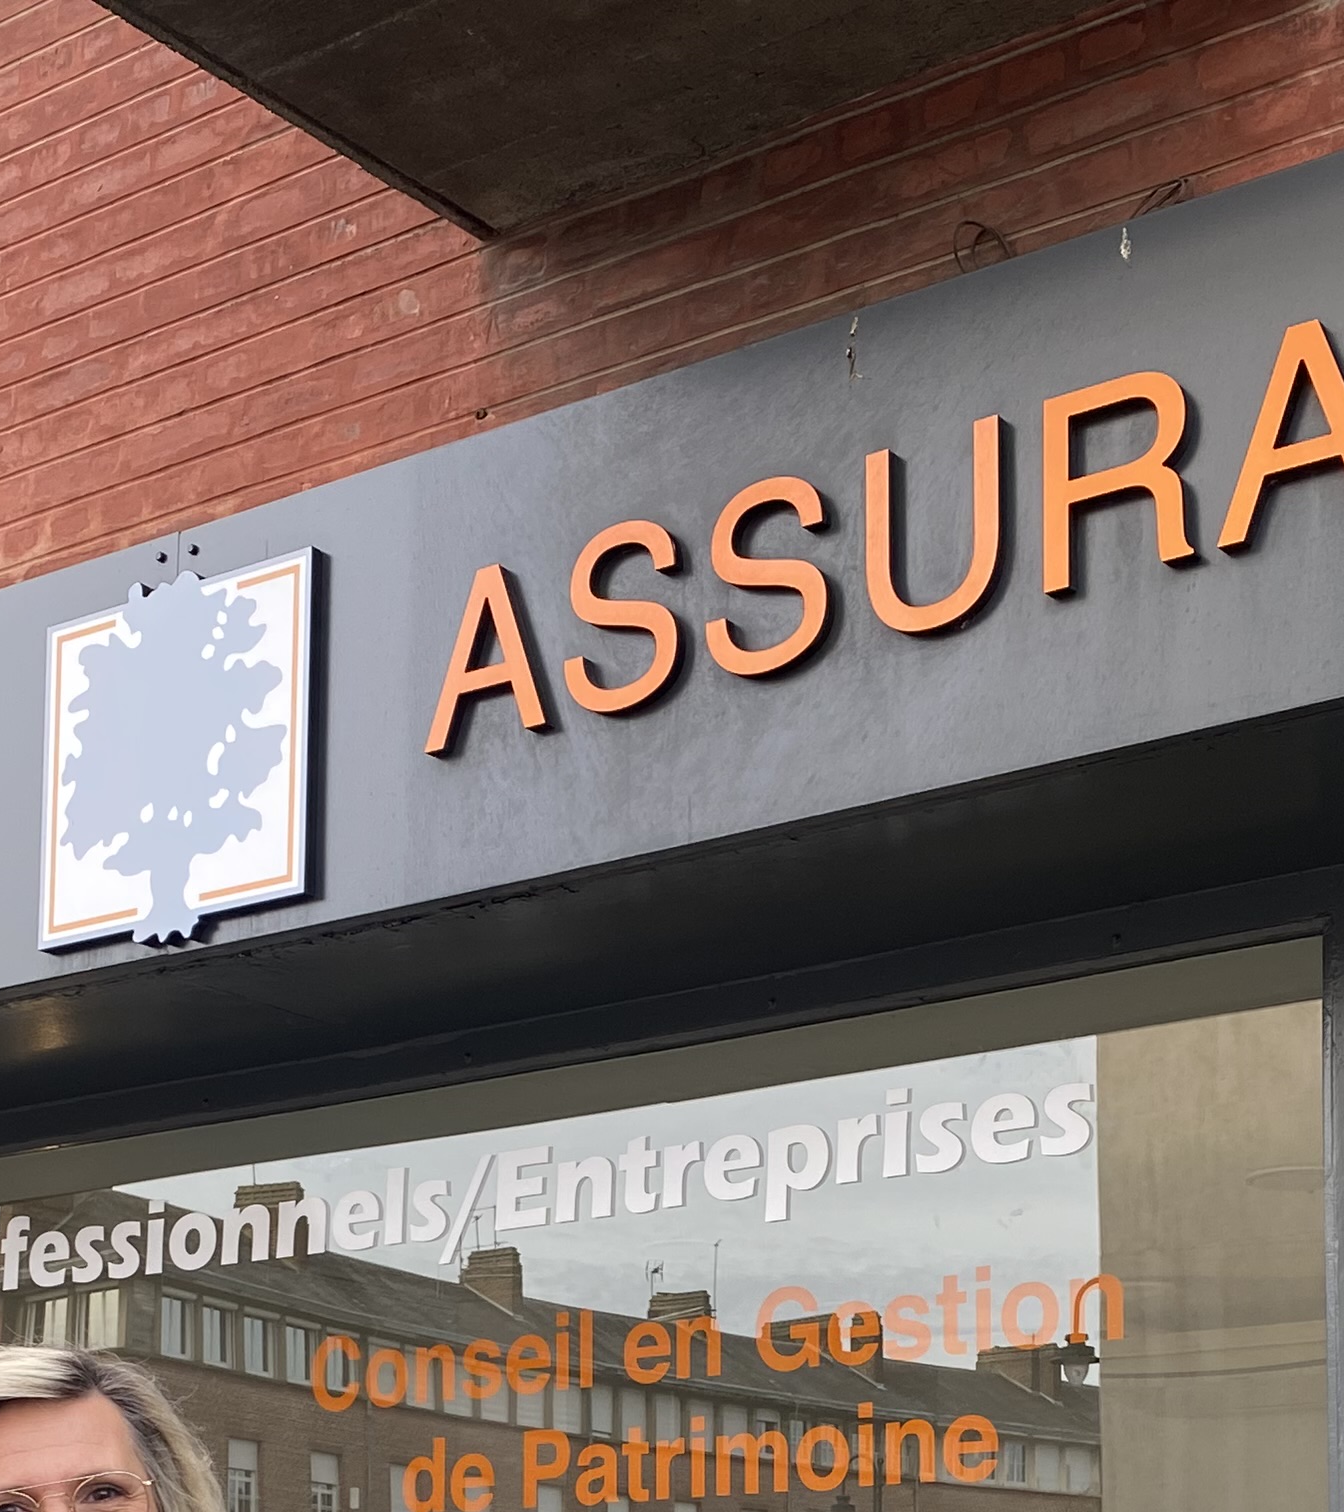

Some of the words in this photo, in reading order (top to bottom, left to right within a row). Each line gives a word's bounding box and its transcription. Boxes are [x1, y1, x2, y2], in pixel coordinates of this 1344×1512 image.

[312, 1309, 594, 1411] Conseil
[623, 1315, 722, 1385] en
[755, 1265, 1125, 1373] Gestion
[522, 1401, 998, 1509] Patrimoine
